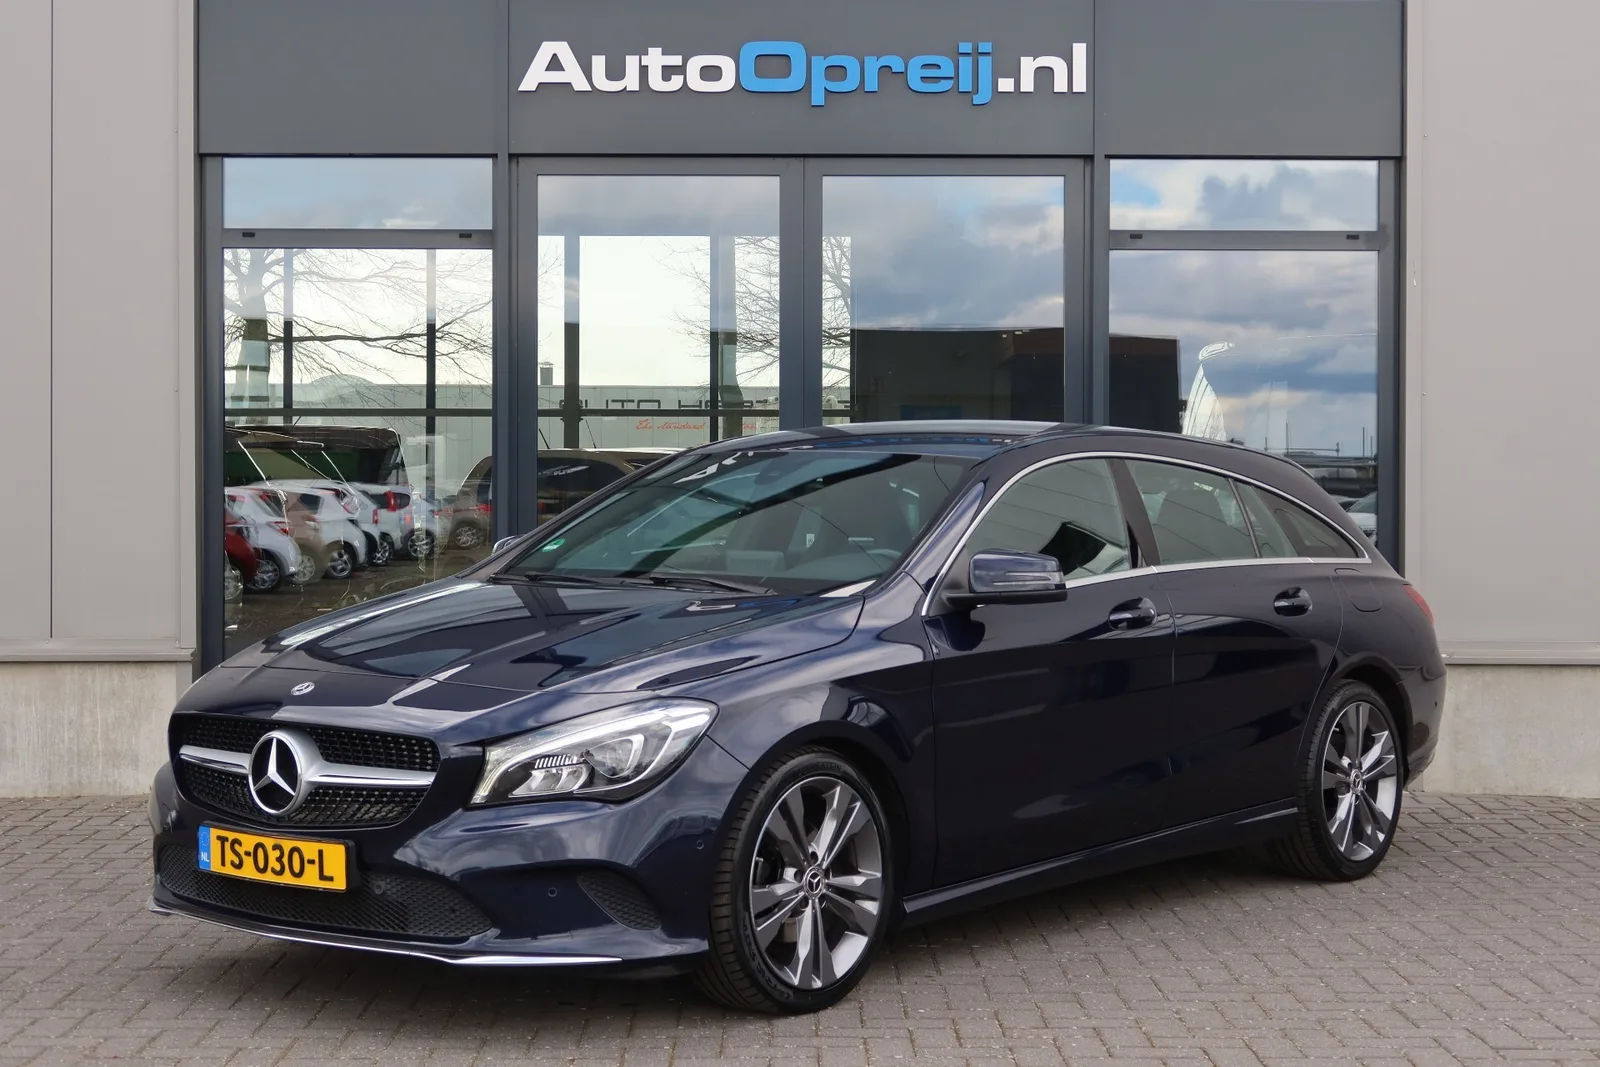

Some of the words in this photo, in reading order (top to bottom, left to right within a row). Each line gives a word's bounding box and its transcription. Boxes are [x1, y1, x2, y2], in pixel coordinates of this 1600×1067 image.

[518, 41, 1087, 106] AutoOpreij.nl
[201, 851, 210, 863] NL
[216, 835, 334, 882] TS-030-L
